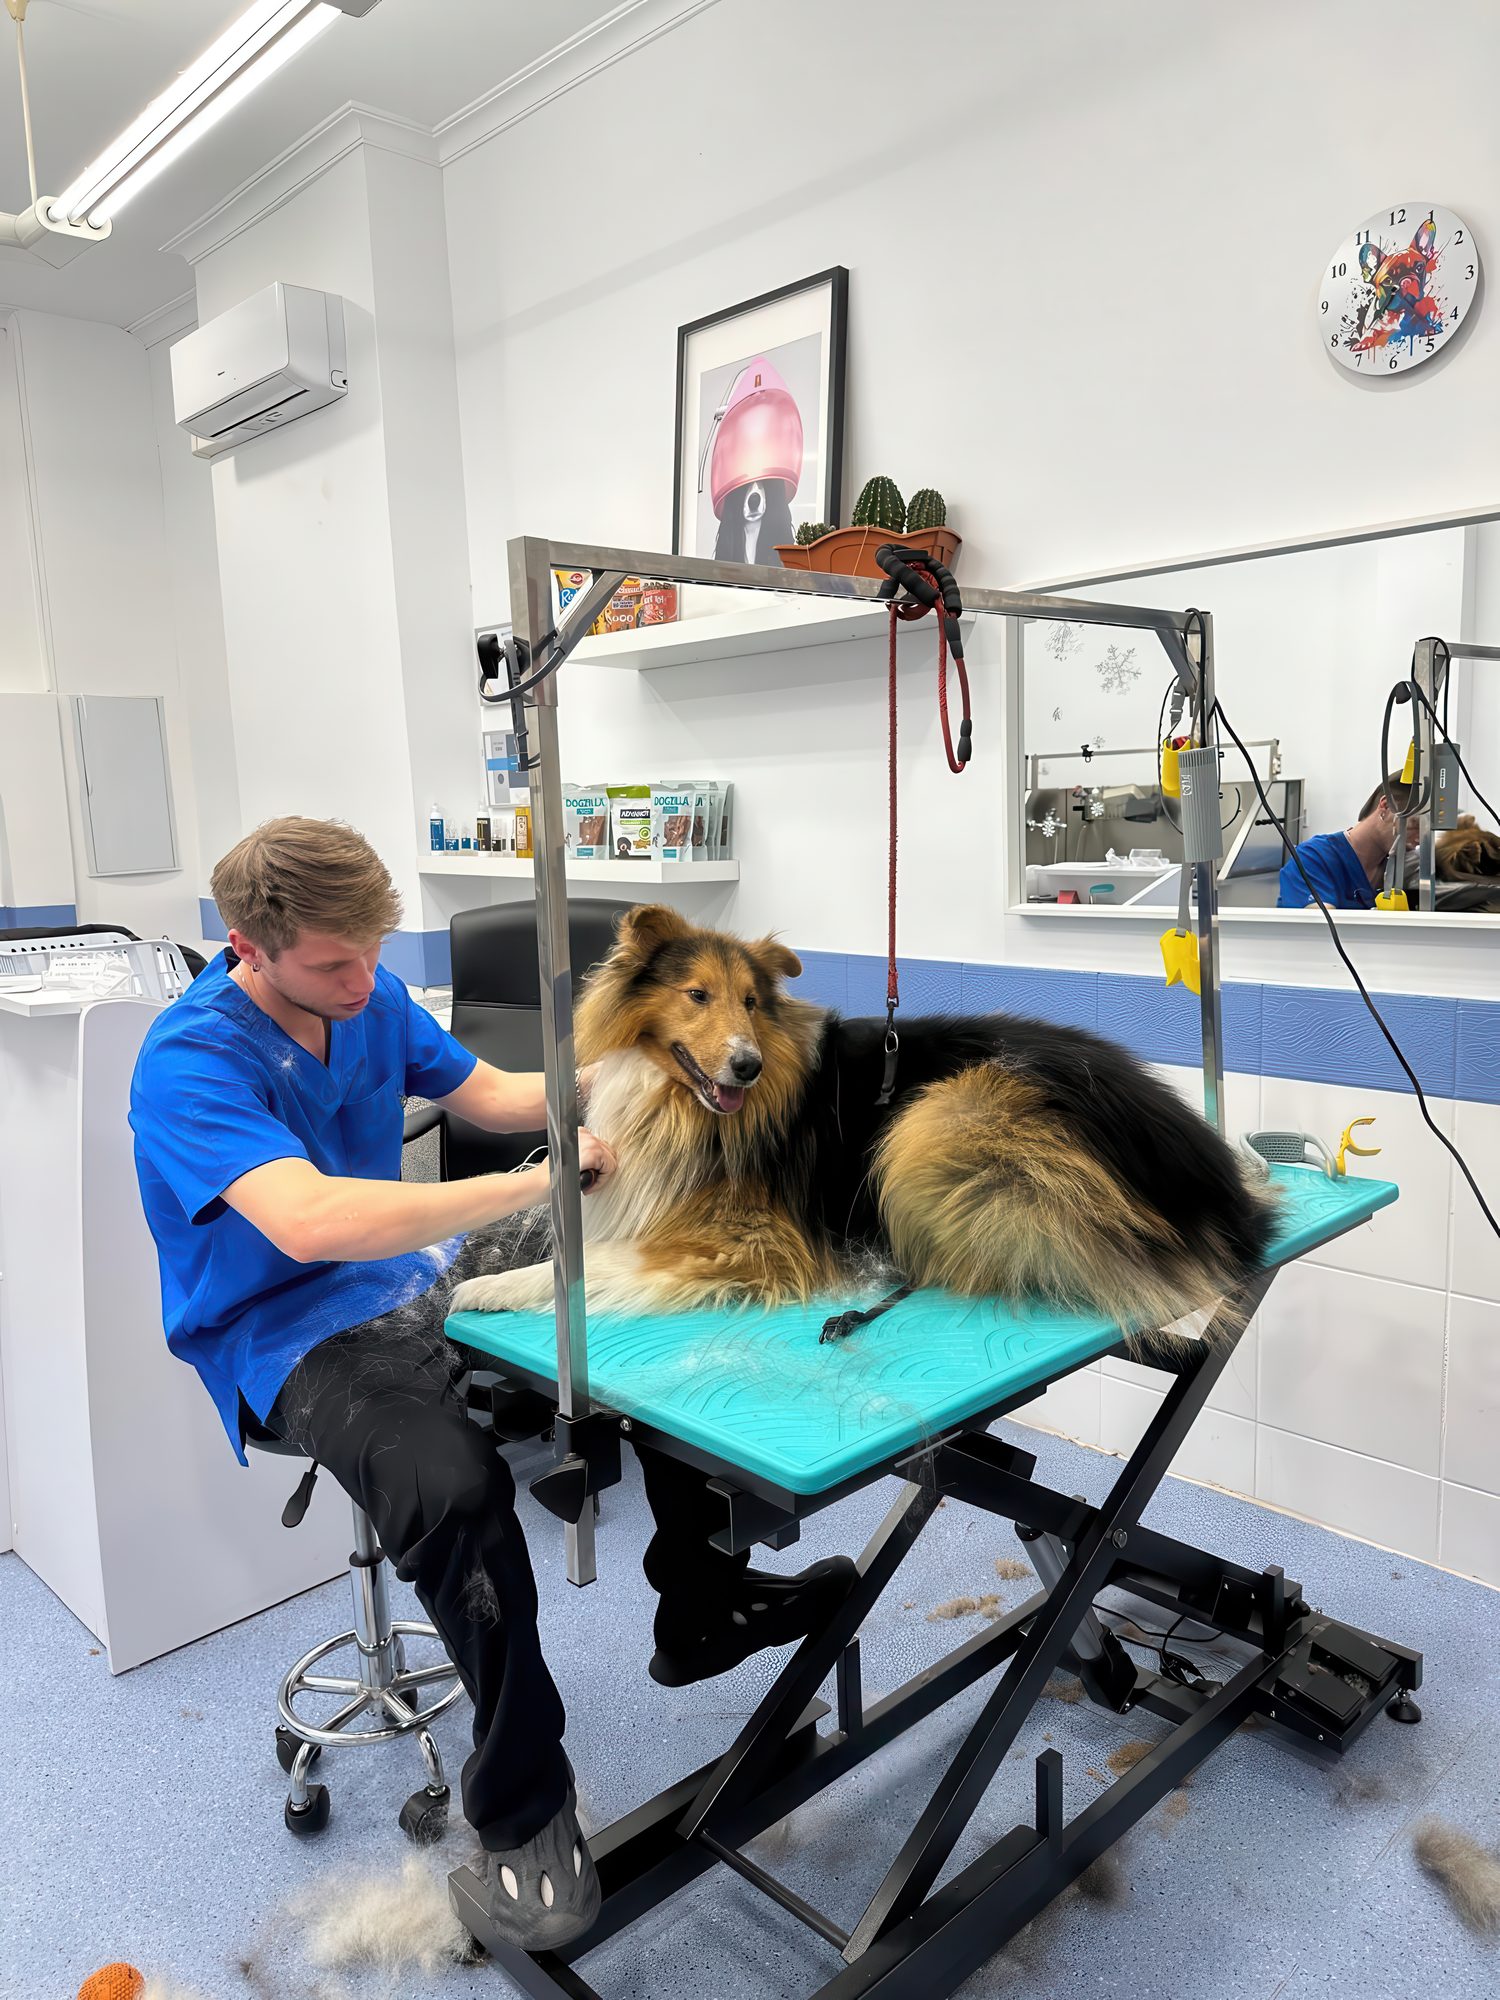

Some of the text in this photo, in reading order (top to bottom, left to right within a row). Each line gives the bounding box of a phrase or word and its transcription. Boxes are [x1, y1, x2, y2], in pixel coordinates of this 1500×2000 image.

[1389, 209, 1406, 226] 12
[1428, 210, 1435, 224] 1
[1355, 229, 1371, 246] 11
[1454, 230, 1464, 245] 2
[1331, 262, 1347, 279] 10
[1464, 264, 1475, 280] 3
[1321, 300, 1329, 315] 9
[1449, 305, 1459, 321] 4
[1331, 333, 1339, 348] 8
[1424, 338, 1435, 353] 5
[1355, 353, 1363, 368] 7
[1389, 354, 1398, 370] 6
[654, 796, 689, 806] DOGZILLA
